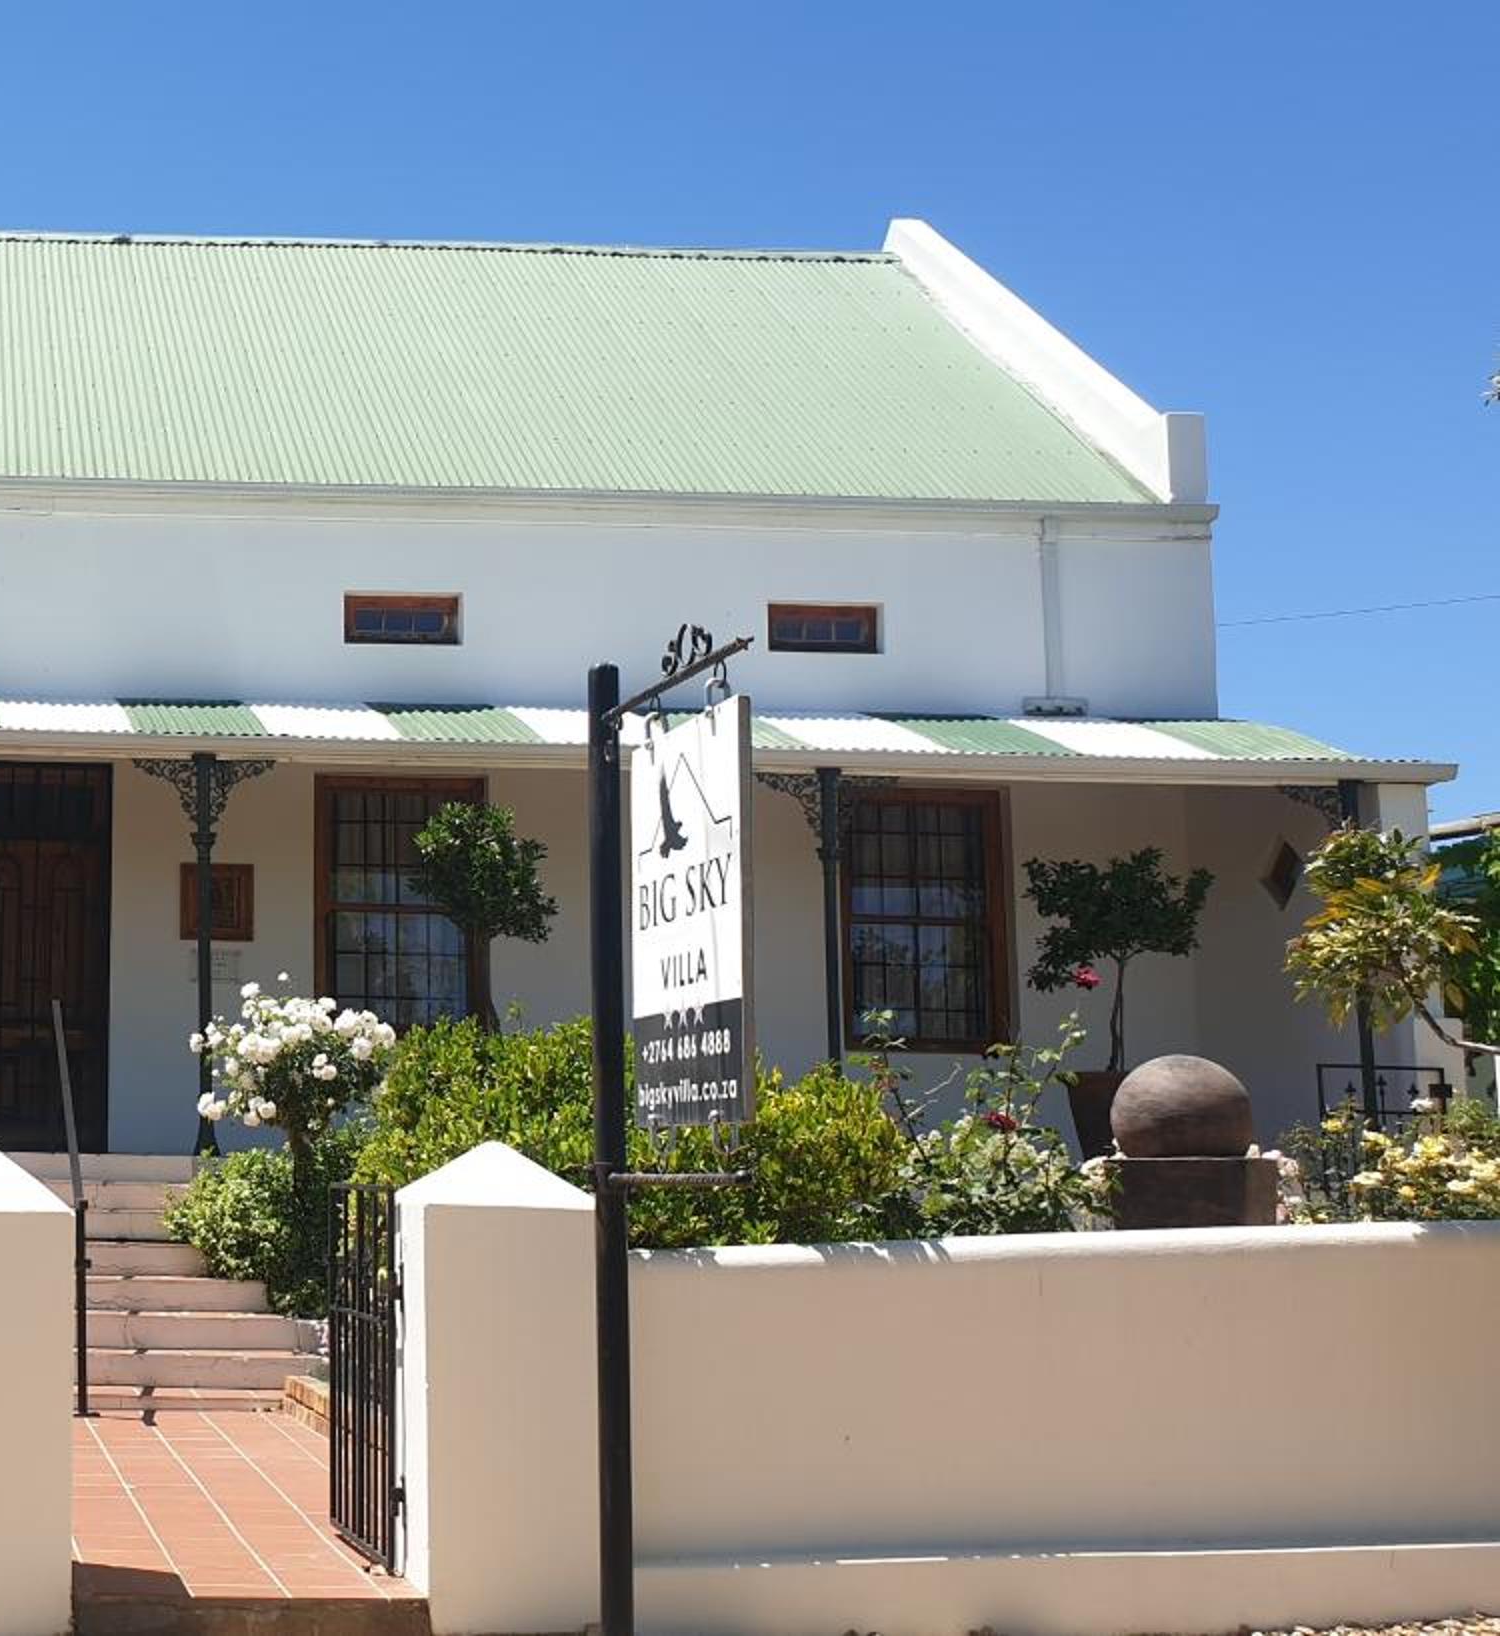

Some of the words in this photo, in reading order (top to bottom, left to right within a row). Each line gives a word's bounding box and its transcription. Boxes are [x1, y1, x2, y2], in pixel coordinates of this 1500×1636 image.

[639, 873, 677, 931] BIG
[685, 853, 732, 917] SKY
[660, 947, 708, 990] VILLA
[642, 1037, 673, 1064] +2764
[701, 1027, 731, 1057] 4888
[638, 1077, 737, 1111] bigskyvilla.co.za
